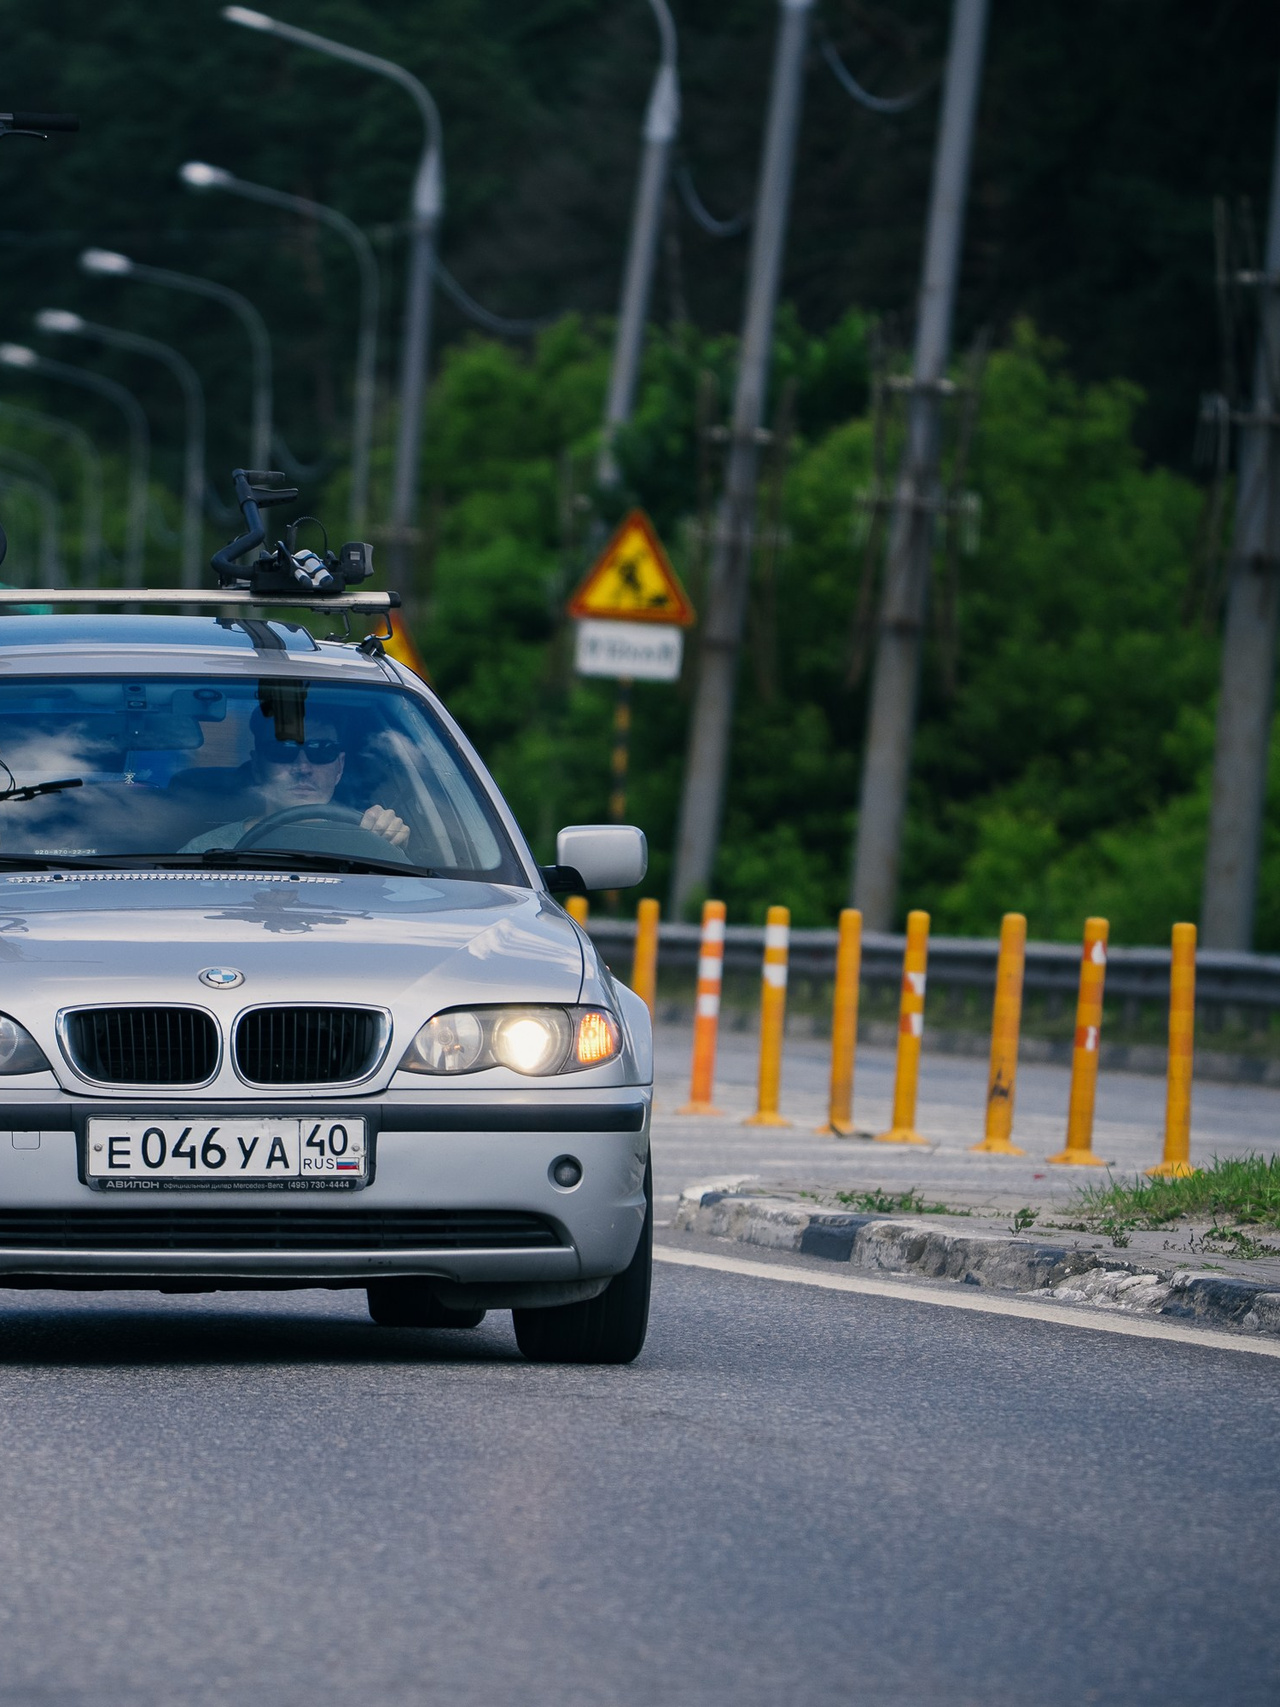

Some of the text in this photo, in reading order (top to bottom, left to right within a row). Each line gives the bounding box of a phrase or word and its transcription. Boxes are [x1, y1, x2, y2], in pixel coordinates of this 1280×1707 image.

[305, 1124, 349, 1157] 40
[303, 1158, 335, 1170] RUS
[106, 1180, 160, 1189] АВИЛОН
[287, 1180, 309, 1190] (495)
[310, 1180, 350, 1189] 730-4444
